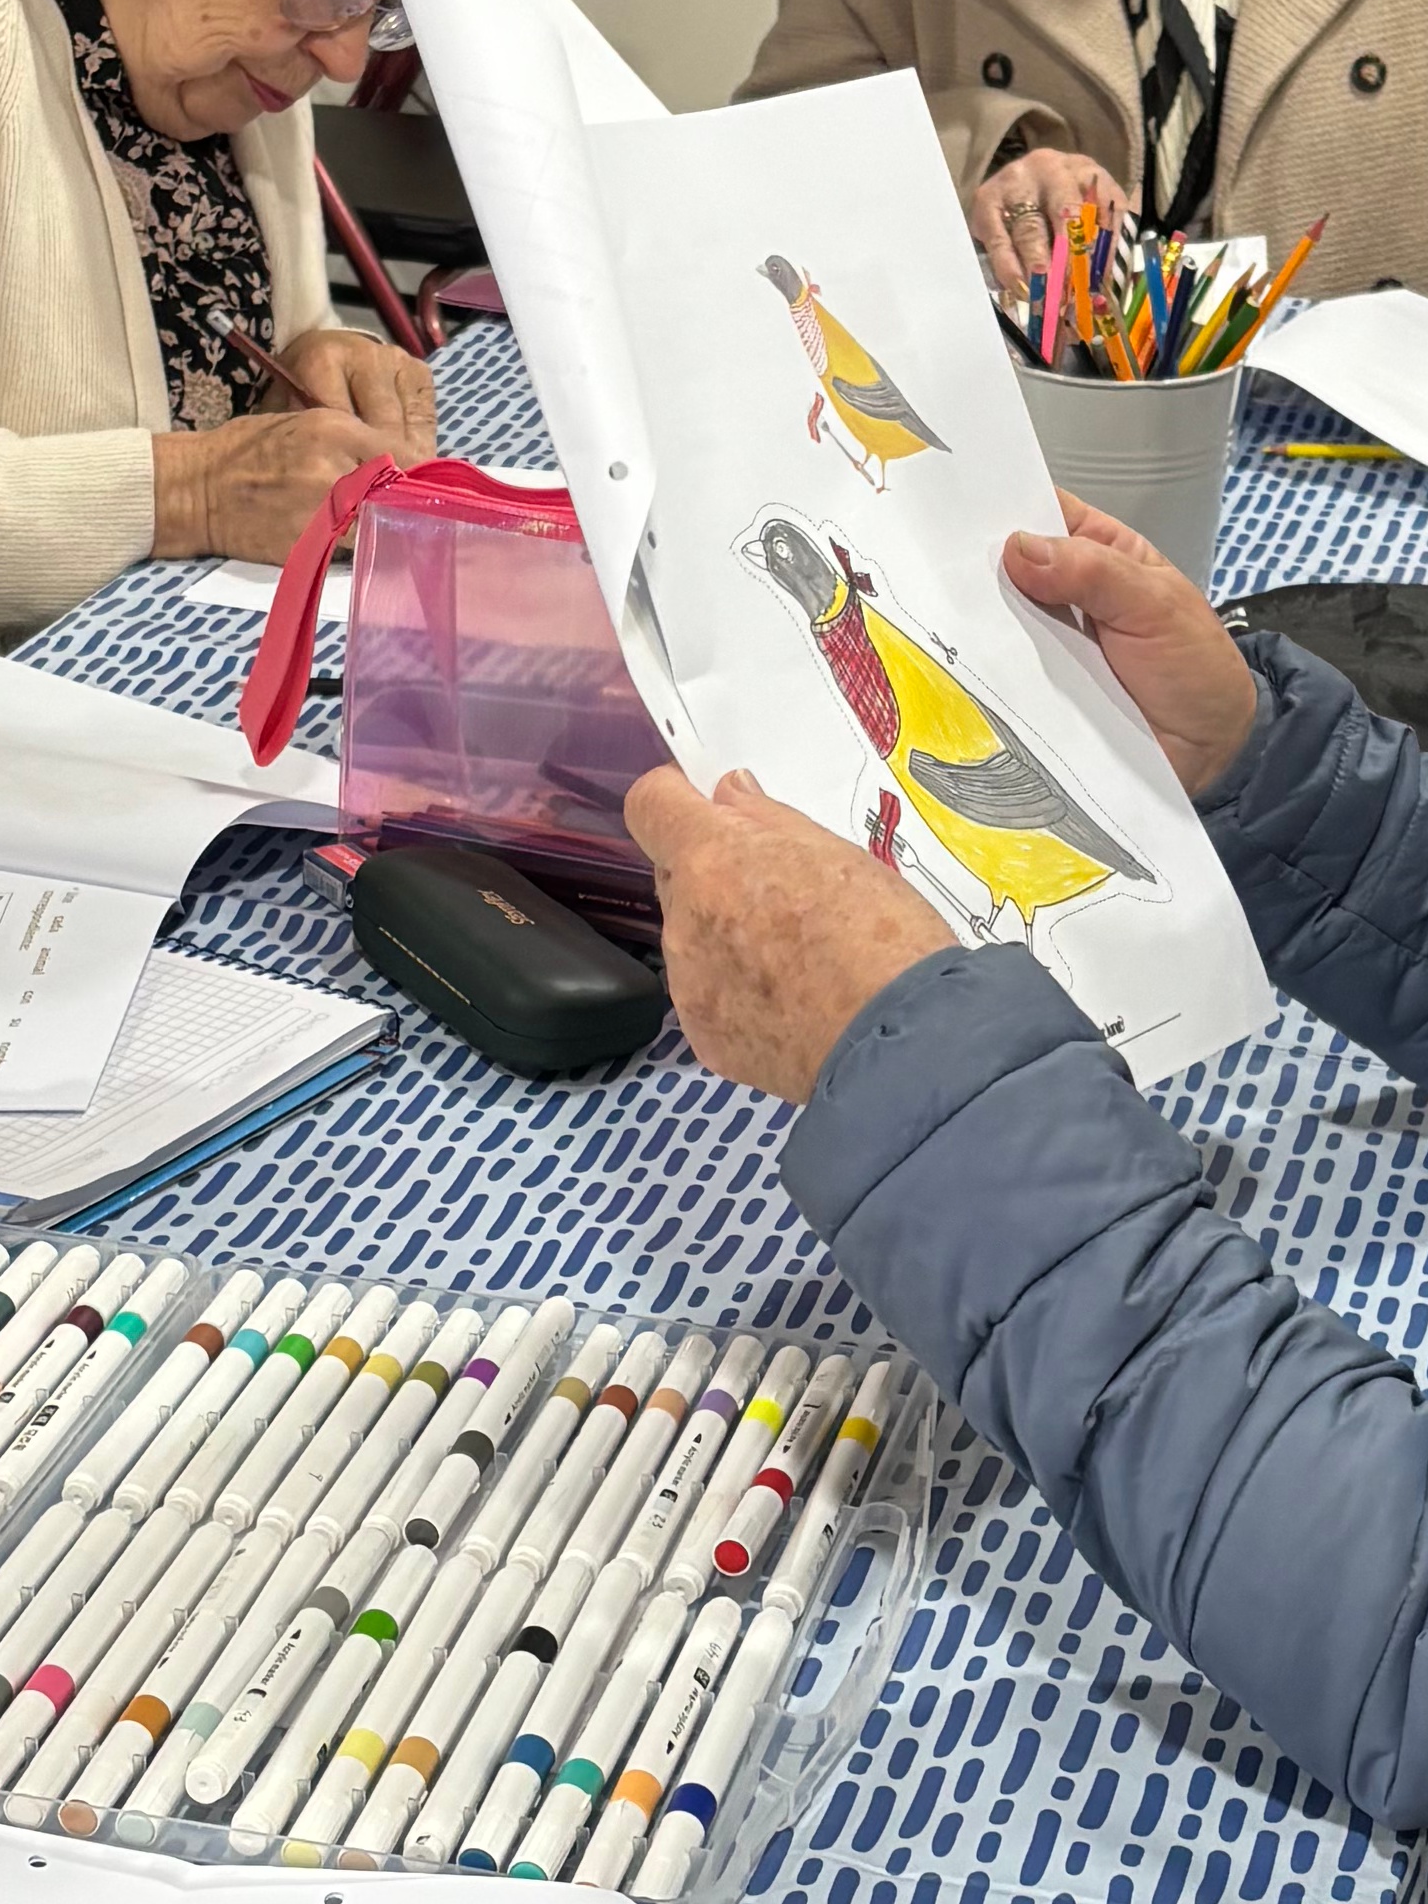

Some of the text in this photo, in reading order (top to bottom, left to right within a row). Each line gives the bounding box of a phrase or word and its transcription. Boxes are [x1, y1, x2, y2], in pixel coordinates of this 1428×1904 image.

[47, 914, 66, 933] cada
[30, 946, 53, 976] animal
[18, 990, 35, 1004] con
[7, 1017, 22, 1027] su
